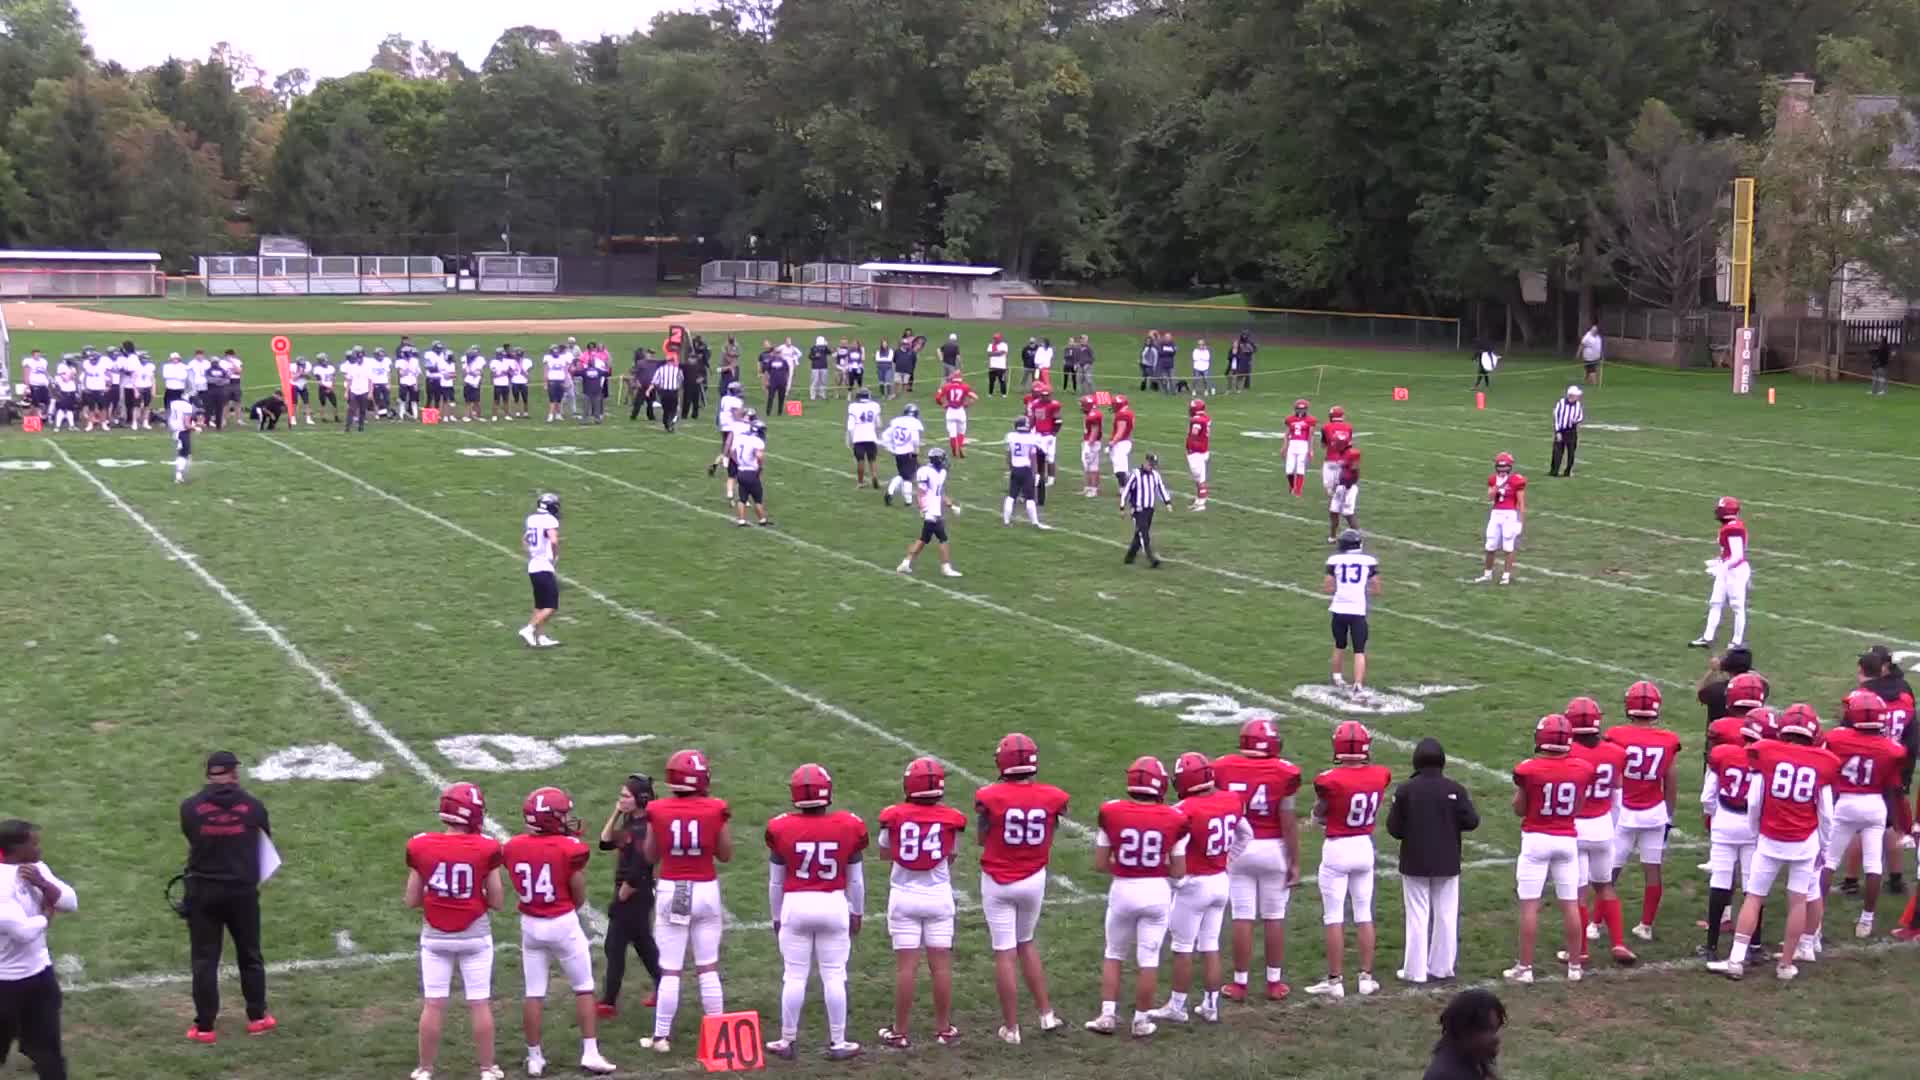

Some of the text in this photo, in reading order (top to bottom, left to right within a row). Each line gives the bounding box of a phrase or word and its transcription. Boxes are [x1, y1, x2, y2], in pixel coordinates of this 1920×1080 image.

[1743, 330, 1752, 359] BIG
[950, 389, 962, 401] 17
[1740, 364, 1750, 393] RED
[1014, 442, 1022, 457] 2
[1340, 563, 1362, 584] 13
[1624, 746, 1664, 780] 27
[1841, 755, 1874, 786] 41
[470, 787, 483, 805] L
[1540, 782, 1576, 816] 19
[1771, 762, 1816, 803] 88
[535, 795, 550, 812] L
[1346, 791, 1379, 827] 81
[670, 818, 702, 856] 11
[899, 821, 942, 861] 84
[1003, 807, 1047, 846] 66
[1206, 816, 1236, 856] 26
[795, 841, 839, 881] 75
[1119, 828, 1163, 868] 28
[428, 861, 474, 899] 40
[514, 862, 555, 903] 34
[713, 1018, 759, 1071] 40
